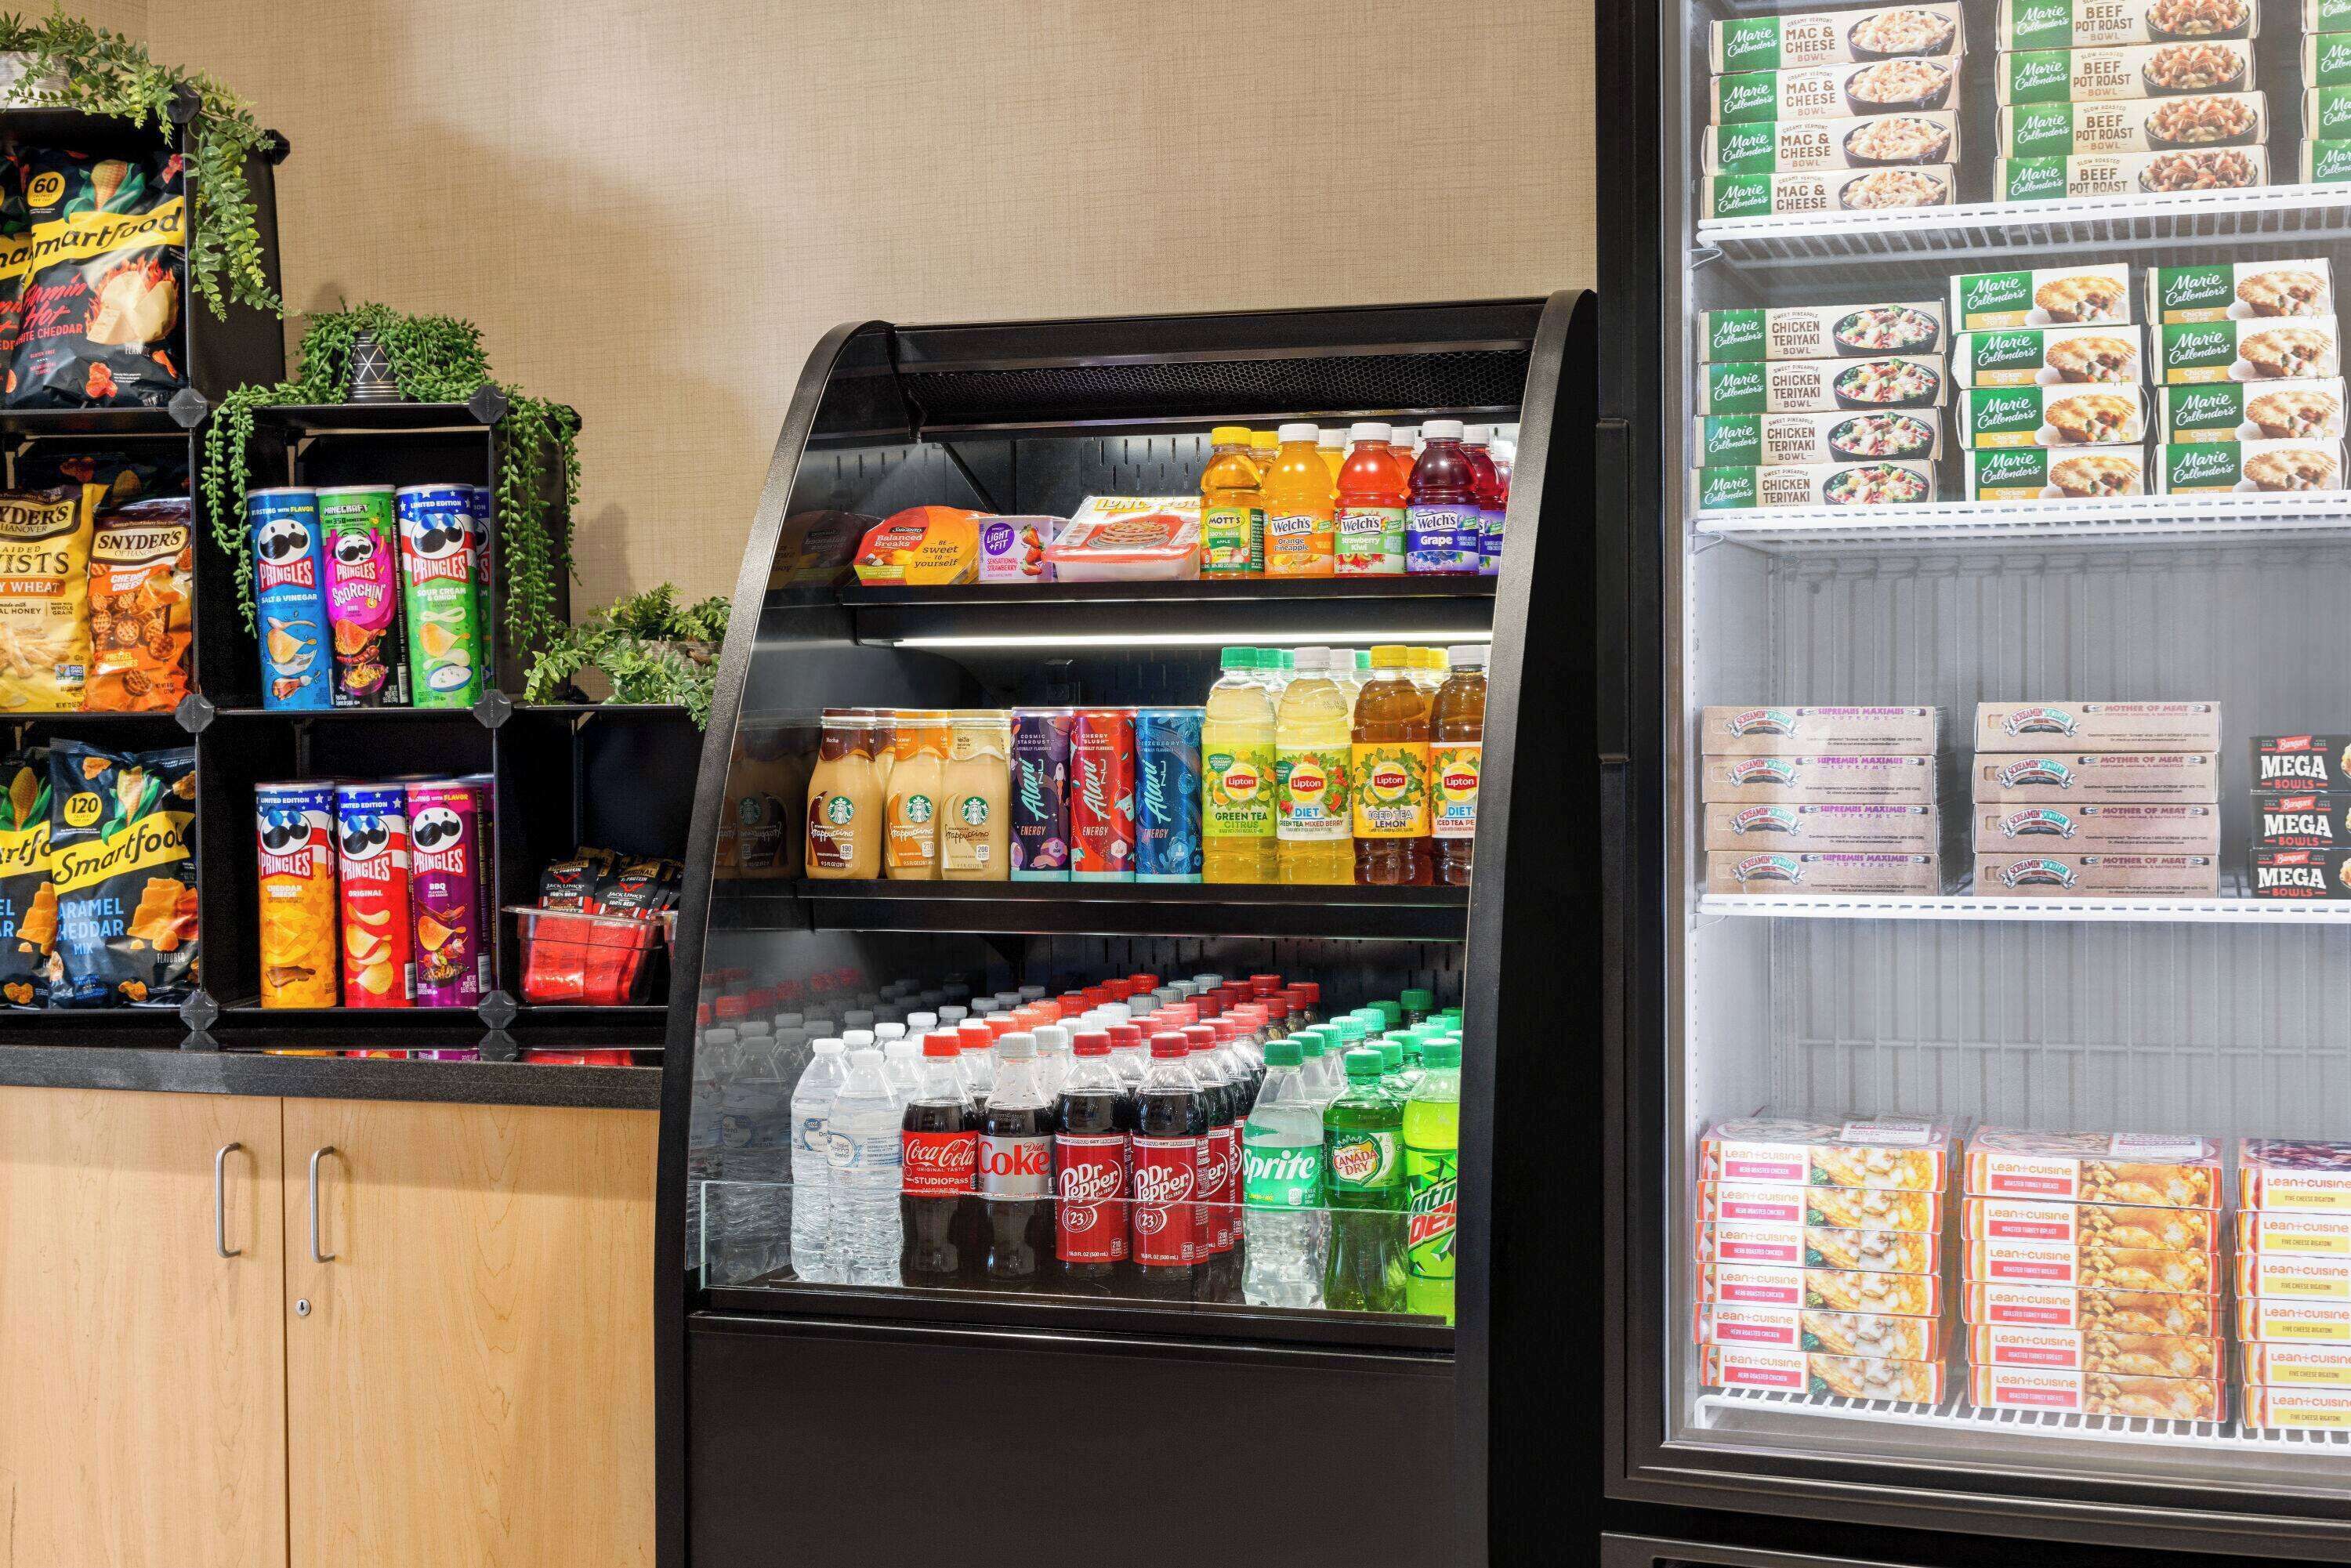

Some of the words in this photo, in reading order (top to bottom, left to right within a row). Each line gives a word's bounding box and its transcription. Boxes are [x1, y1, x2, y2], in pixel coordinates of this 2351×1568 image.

[1728, 28, 1774, 45] Marie
[1786, 27, 1817, 41] MAC
[1824, 27, 1835, 38] &
[1727, 39, 1777, 57] Callender's
[1786, 38, 1835, 53] CHEESE
[1797, 53, 1826, 62] BOWL
[2016, 61, 2064, 79] Marie
[2084, 61, 2121, 74] BEEF
[1786, 80, 1818, 94] MAC
[1824, 80, 1835, 91] &
[2015, 72, 2067, 91] Callender's
[2073, 75, 2096, 88] POT
[2096, 74, 2132, 86] ROAST
[1786, 92, 1836, 107] CHEESE
[2088, 88, 2118, 96] BOWL
[34, 177, 59, 194] 60
[2166, 273, 2222, 293] Marie
[2165, 285, 2228, 306] Callender's
[38, 324, 82, 339] CHEDDAR
[1714, 320, 1760, 337] Marie
[1772, 321, 1820, 334] CHICKEN
[1714, 331, 1762, 348] Callender's
[1773, 334, 1820, 346] TERIYAKI
[1978, 335, 2032, 353] Marie
[1977, 347, 2038, 366] Callender's
[0, 505, 68, 526] YDER'S
[324, 504, 369, 516] MINECRAFT
[1273, 518, 1310, 533] Welch's
[1342, 519, 1380, 532] Welch's
[1417, 514, 1457, 528] Welch's
[1, 525, 47, 534] HANOVER
[98, 530, 182, 549] SNYDER'S
[1341, 537, 1381, 546] Strawberry
[1420, 535, 1453, 546] Grape
[922, 545, 958, 554] sweet
[0, 552, 69, 574] ISTS
[412, 552, 469, 581] PRINGLES
[914, 559, 958, 569] yourself
[259, 559, 313, 587] PRINGLES
[336, 562, 376, 582] PRINGLES
[10, 581, 60, 593] WHEAT
[1038, 759, 1044, 784] NU
[1100, 759, 1107, 784] NU
[2260, 755, 2327, 780] MEGA
[1020, 756, 1049, 821] Alani
[1082, 757, 1110, 821] Alani
[1293, 778, 1321, 788] Lipton
[1446, 777, 1474, 786] Lipton
[2274, 779, 2314, 790] BOWLS
[1143, 758, 1172, 824] Alani
[71, 797, 99, 813] 120
[1295, 808, 1319, 817] DIET
[1447, 806, 1472, 817] DIET
[1215, 812, 1250, 820] GREEN
[1252, 812, 1268, 820] TEA
[1368, 810, 1393, 820] ICED
[1393, 810, 1414, 820] TEA
[1020, 826, 1046, 836] ENERGY
[1082, 826, 1109, 836] ENERGY
[1144, 828, 1169, 838] ENERGY
[2264, 813, 2333, 838] MEGA
[2278, 837, 2319, 847] BOWLS
[261, 848, 311, 876] PRINGLES
[414, 845, 464, 875] PRINGLES
[342, 859, 390, 882] PRINGLES
[59, 898, 124, 918] ARAMEL
[56, 918, 124, 941] HEDDAR
[74, 943, 93, 955] MIX
[157, 952, 185, 964] FLAVORED
[906, 1138, 977, 1168] Coca-Cola
[1023, 1142, 1045, 1153] Diet
[980, 1141, 1049, 1176] Coke
[1243, 1149, 1316, 1184] Sprite
[1334, 1150, 1378, 1169] CANADA
[1078, 1163, 1103, 1184] Dr
[1148, 1165, 1172, 1186] Dr
[1345, 1161, 1369, 1175] DRY
[1060, 1168, 1118, 1203] Pepper
[1135, 1169, 1190, 1203] Pepper
[1070, 1211, 1084, 1226] 23
